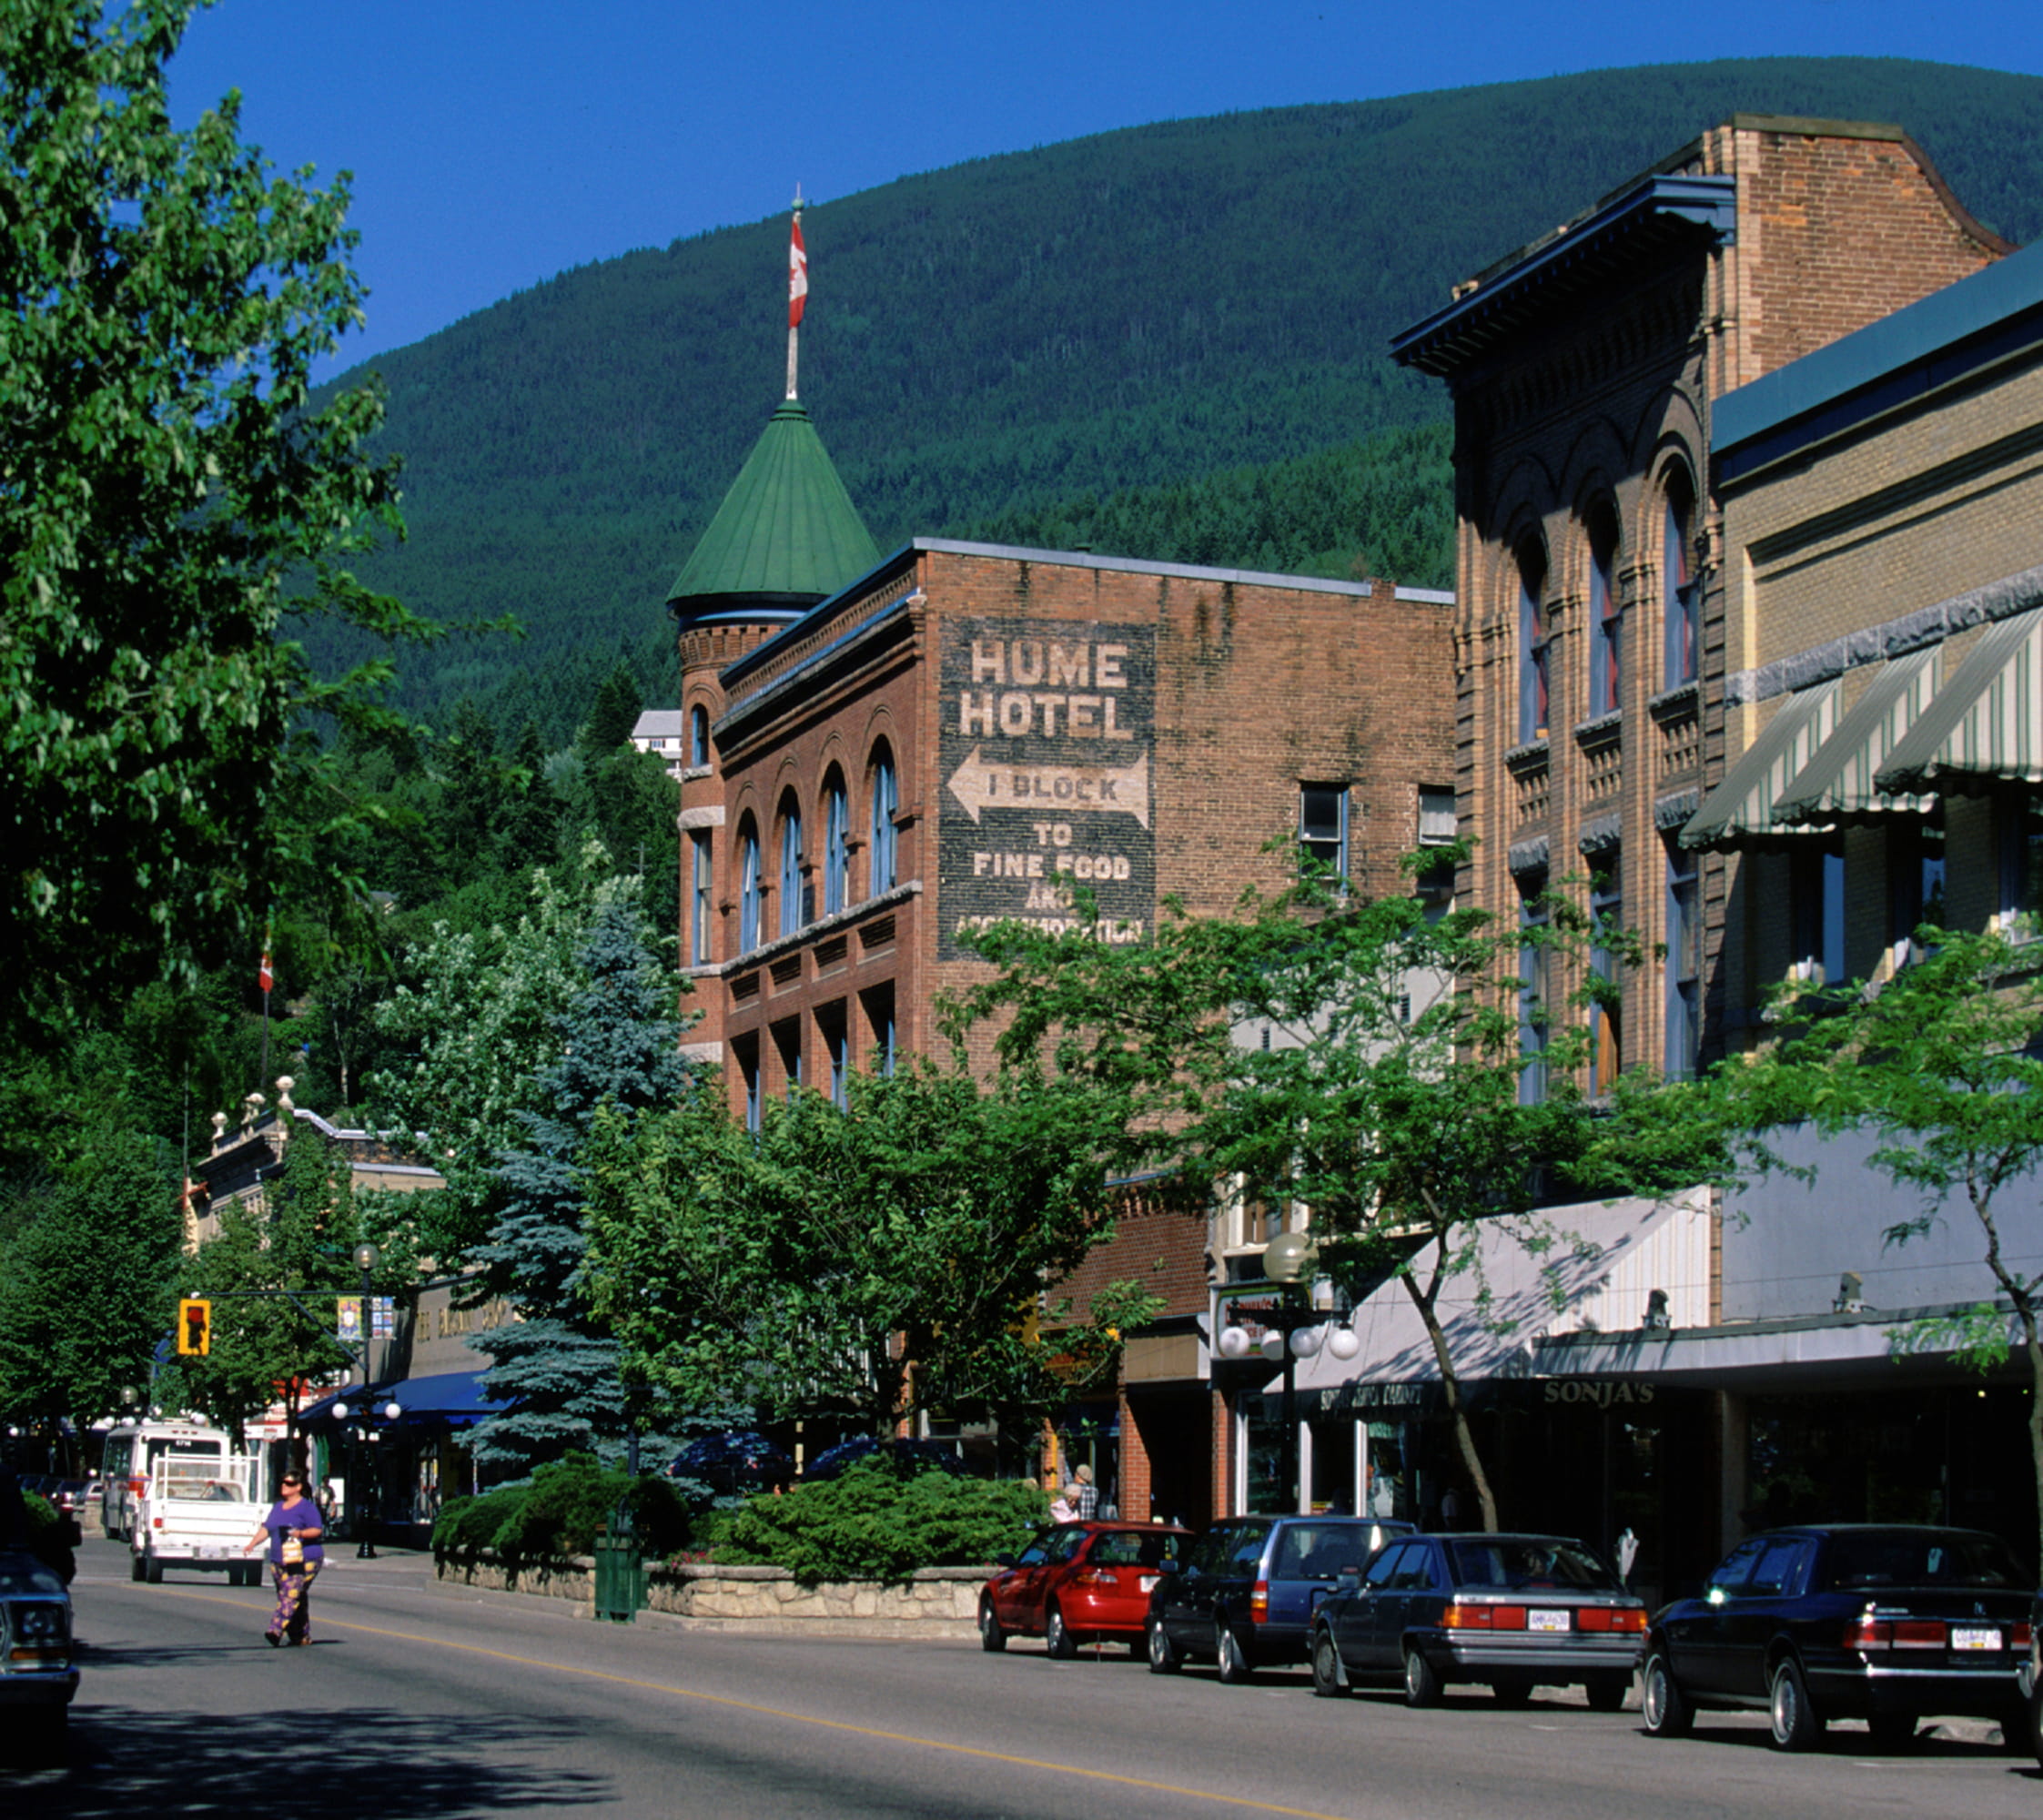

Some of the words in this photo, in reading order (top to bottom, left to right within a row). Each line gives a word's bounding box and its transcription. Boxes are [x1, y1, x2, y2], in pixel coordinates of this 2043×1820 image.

[971, 640, 1129, 688] HUME
[960, 691, 1134, 740] HOTEL
[1013, 775, 1118, 801] BLOCK
[1033, 824, 1074, 846] TO
[973, 853, 1045, 877] FINE
[1057, 854, 1130, 880] FOOD
[1544, 1381, 1654, 1409] SONJA'S
